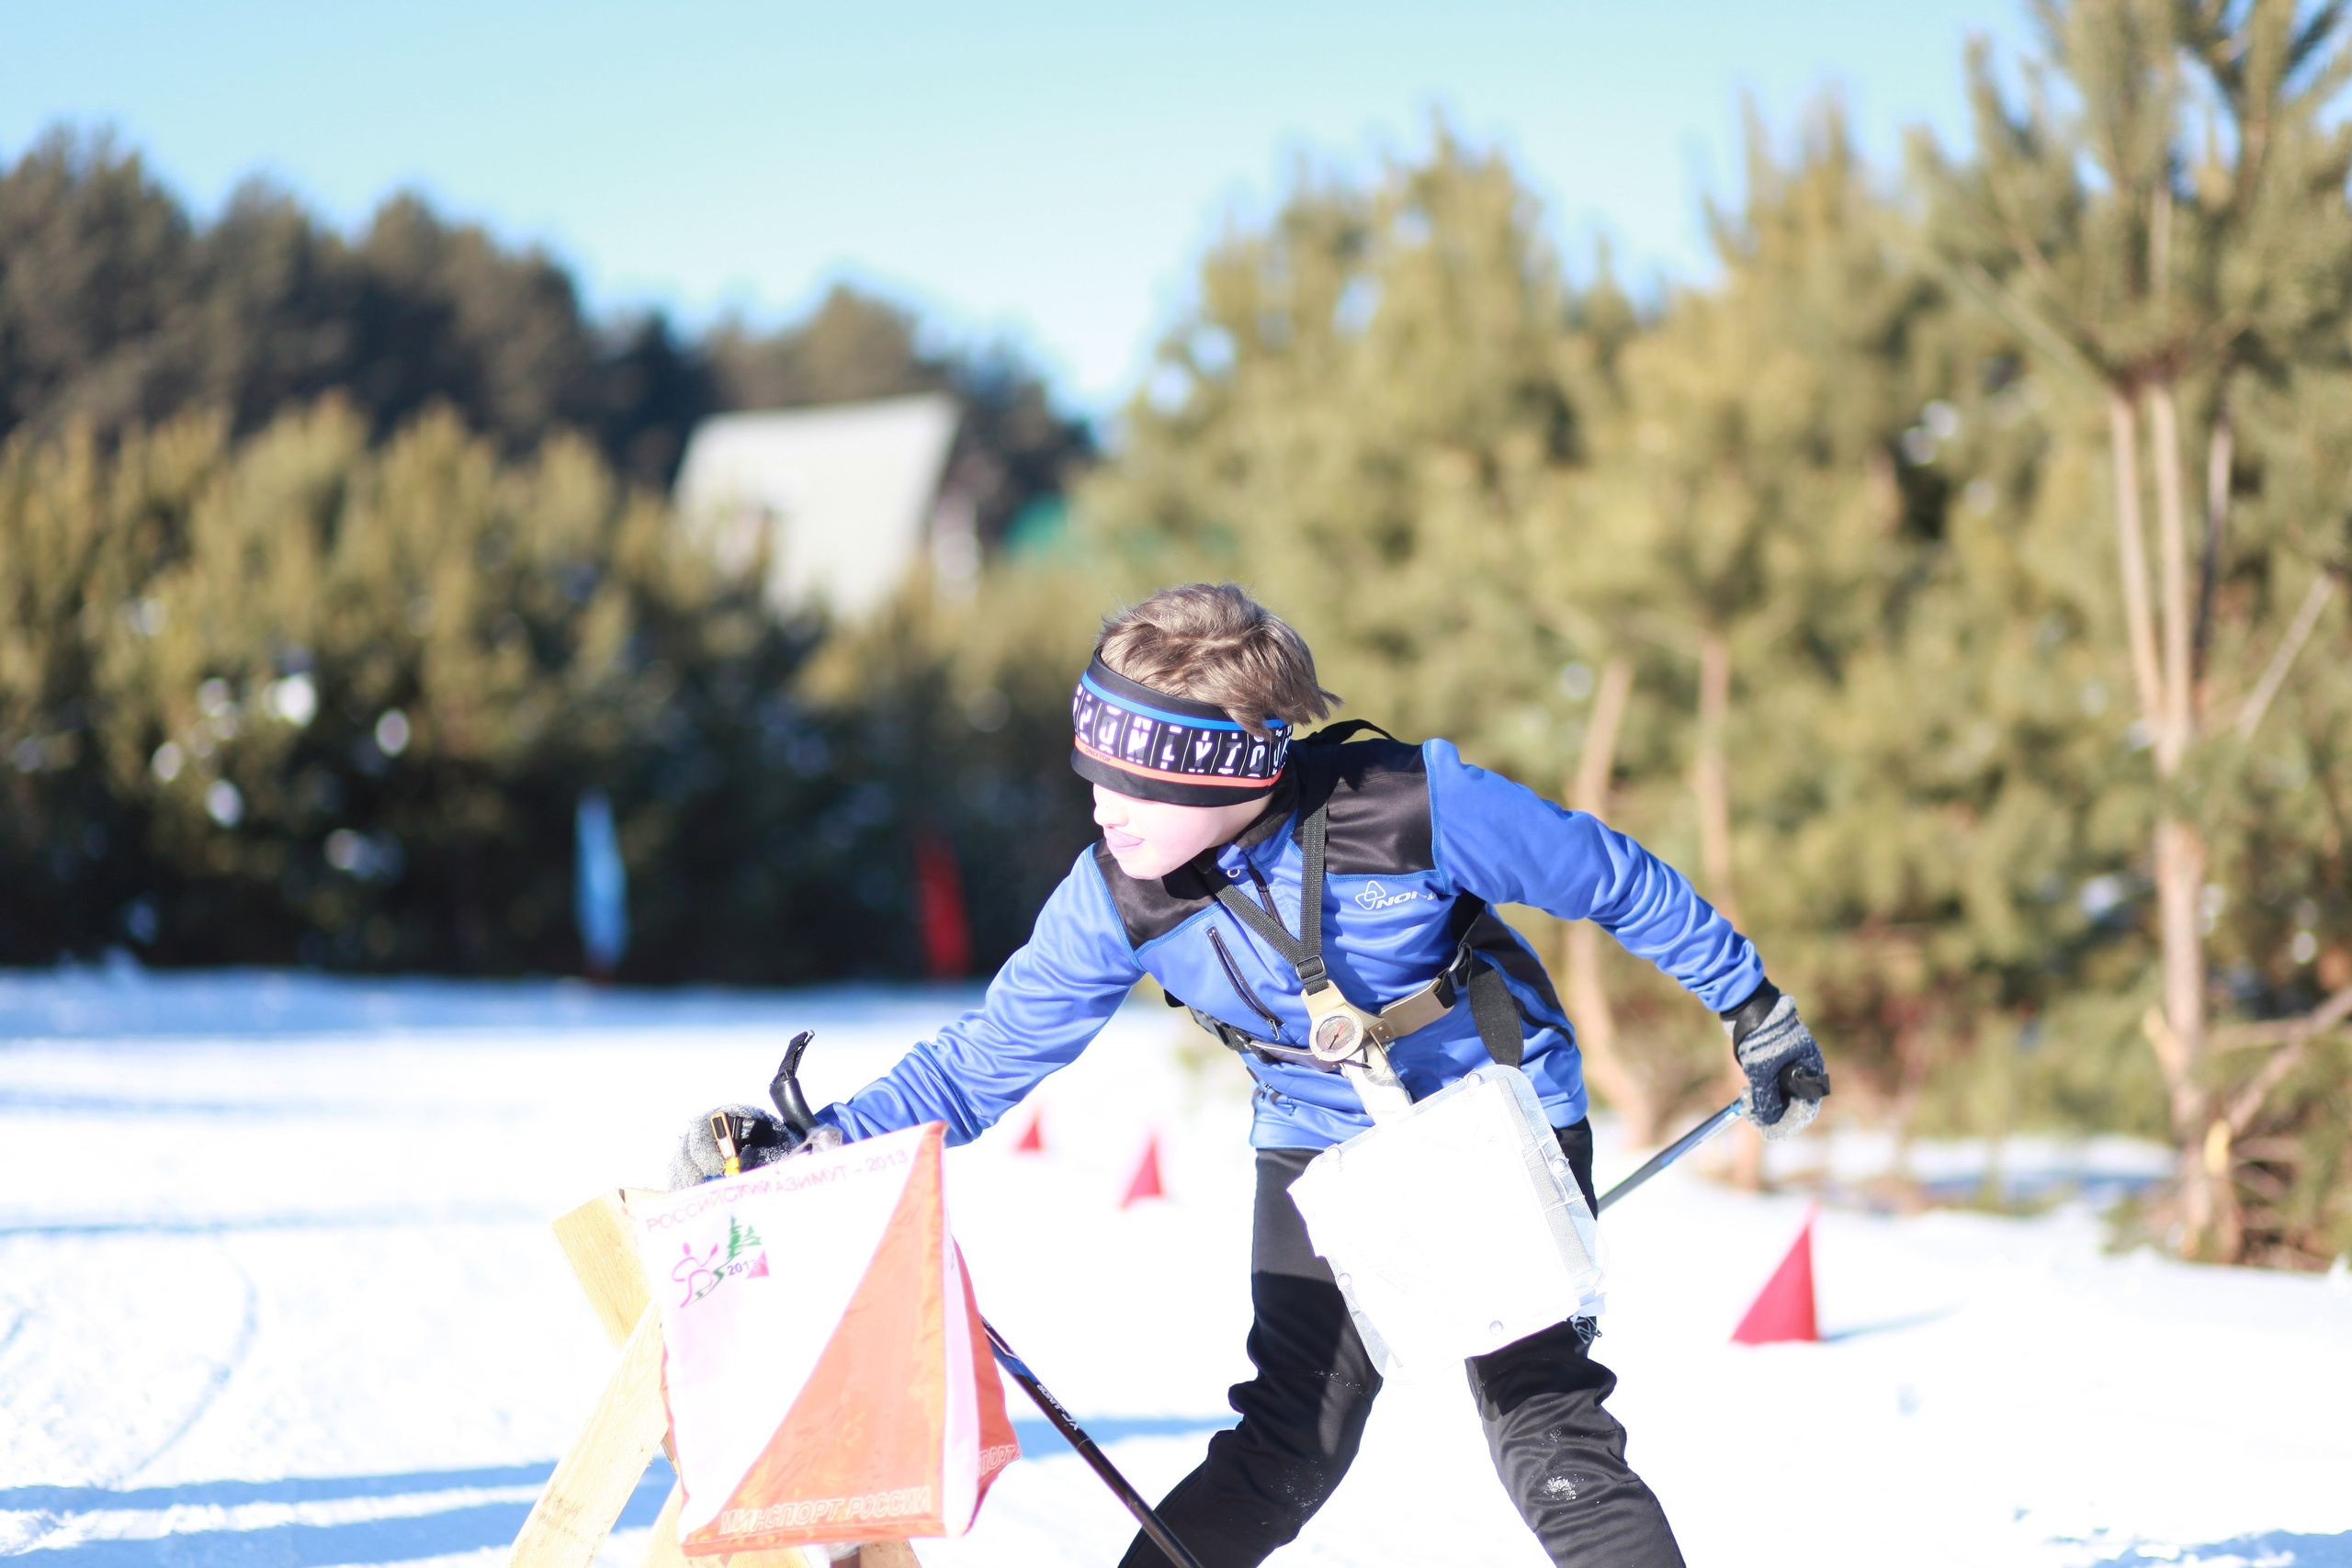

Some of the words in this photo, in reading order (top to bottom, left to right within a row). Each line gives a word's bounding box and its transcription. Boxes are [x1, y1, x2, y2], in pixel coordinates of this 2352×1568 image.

[1084, 747, 1112, 762] ONLYTOP
[645, 1179, 773, 1232] РОССИЙСКИЙ
[775, 1164, 848, 1194] АЗИМУТ
[865, 1148, 909, 1173] 2013
[1036, 1384, 1065, 1413] JUNIOR
[718, 1497, 844, 1535] МИНСПОРТ
[845, 1485, 931, 1520] РОССИИ
